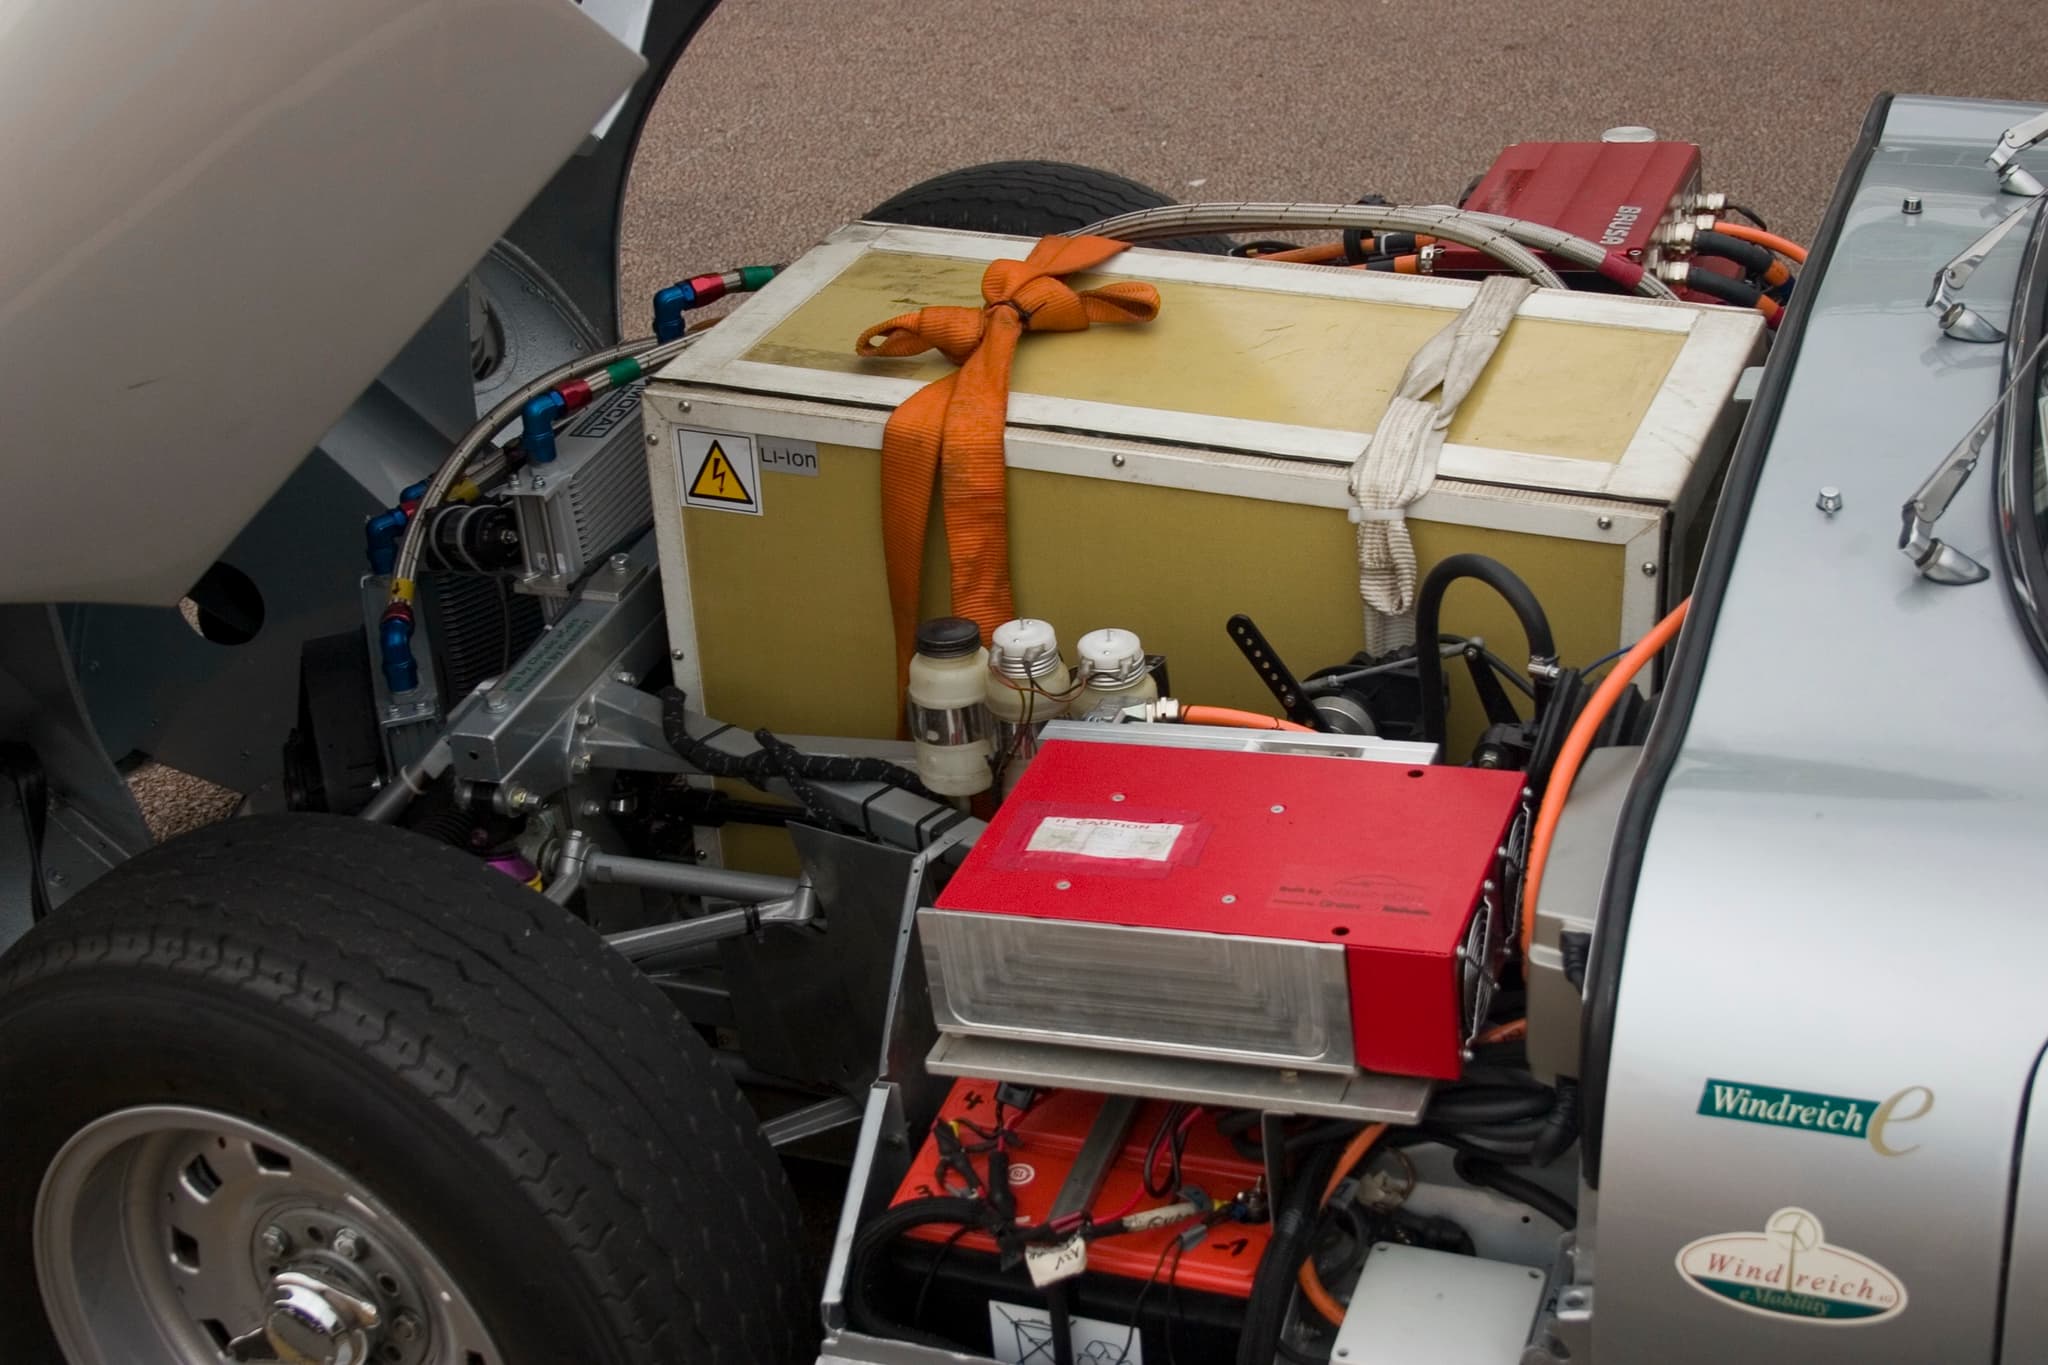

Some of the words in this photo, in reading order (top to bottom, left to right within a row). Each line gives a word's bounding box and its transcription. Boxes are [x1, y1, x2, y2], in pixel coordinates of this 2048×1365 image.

[1600, 205, 1642, 245] BRUSA
[1076, 819, 1150, 831] CAUTION
[1713, 1084, 1865, 1133] Windreich
[1867, 1085, 1935, 1157] e
